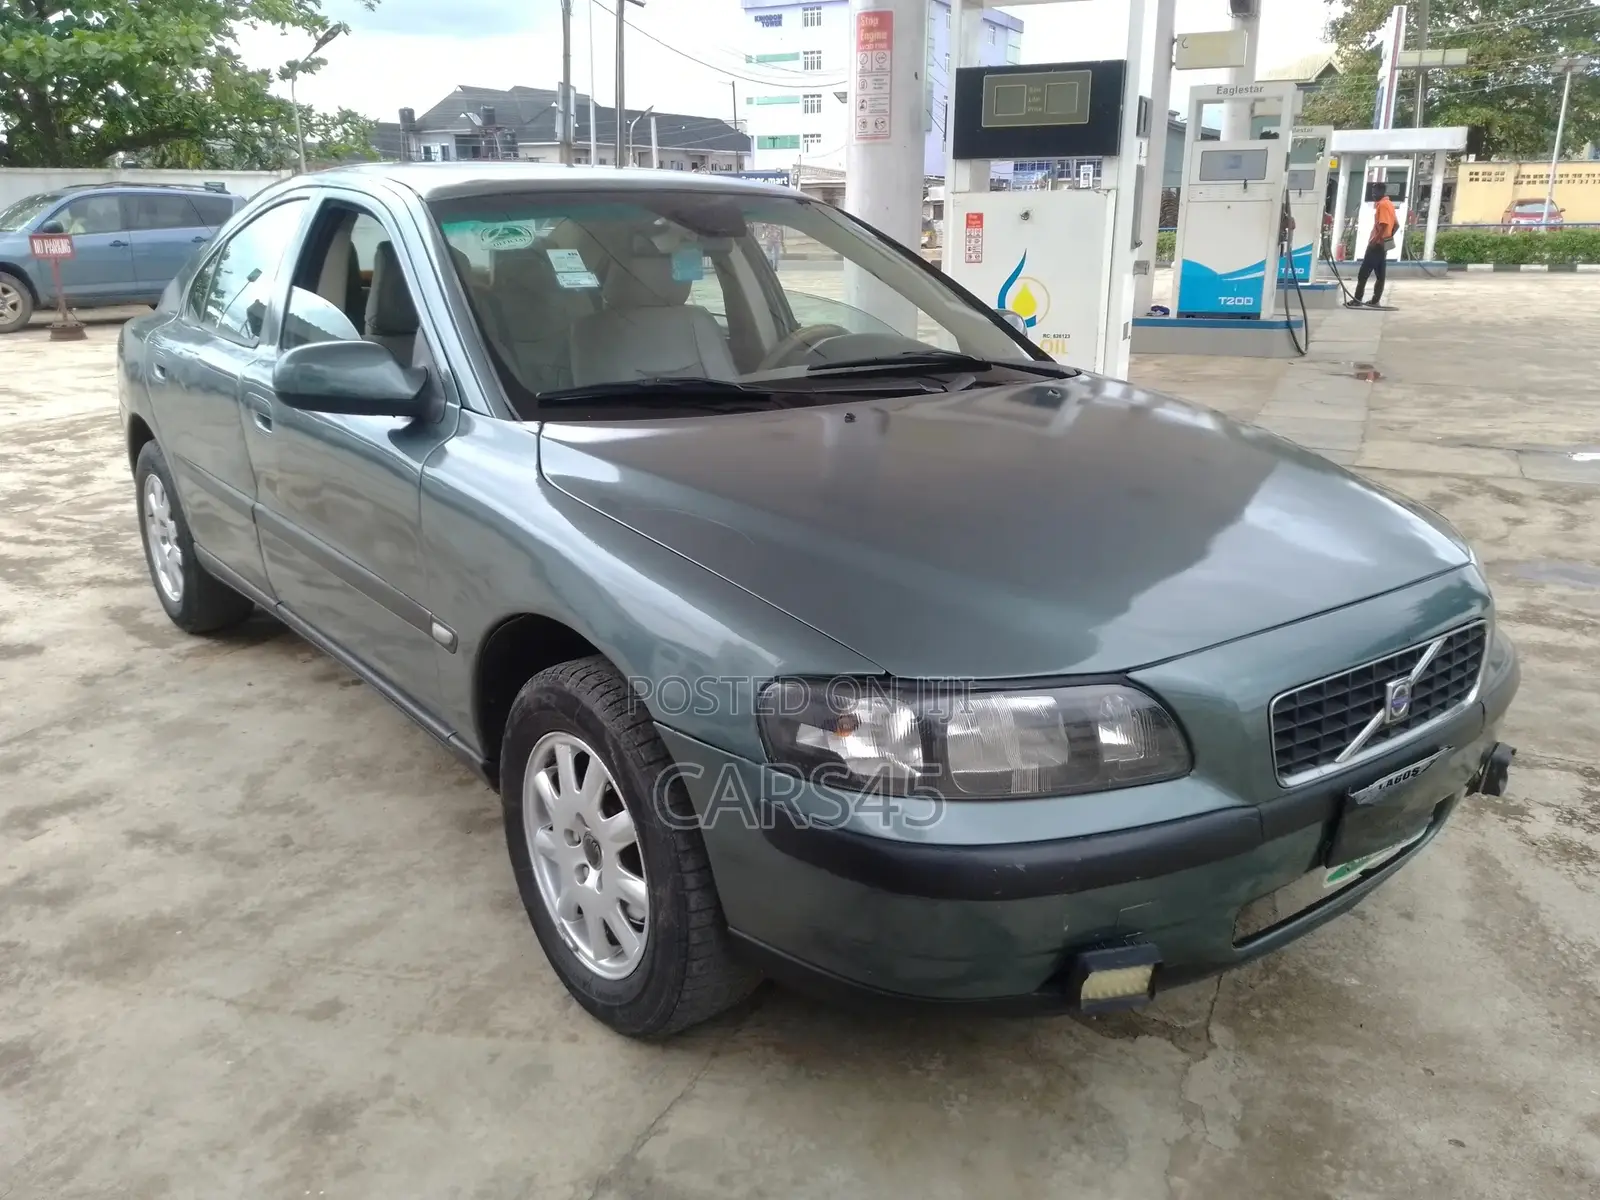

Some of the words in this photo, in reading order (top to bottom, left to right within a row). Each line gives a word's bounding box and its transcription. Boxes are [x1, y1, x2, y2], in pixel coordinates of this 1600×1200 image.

[860, 15, 879, 27] Stop
[860, 29, 888, 42] Engine
[1216, 85, 1265, 96] Eaglestar
[33, 239, 44, 254] NO
[43, 238, 71, 254] PARKING
[1218, 296, 1254, 306] T200
[1040, 339, 1069, 355] OIL
[1378, 766, 1421, 790] LAGOS
